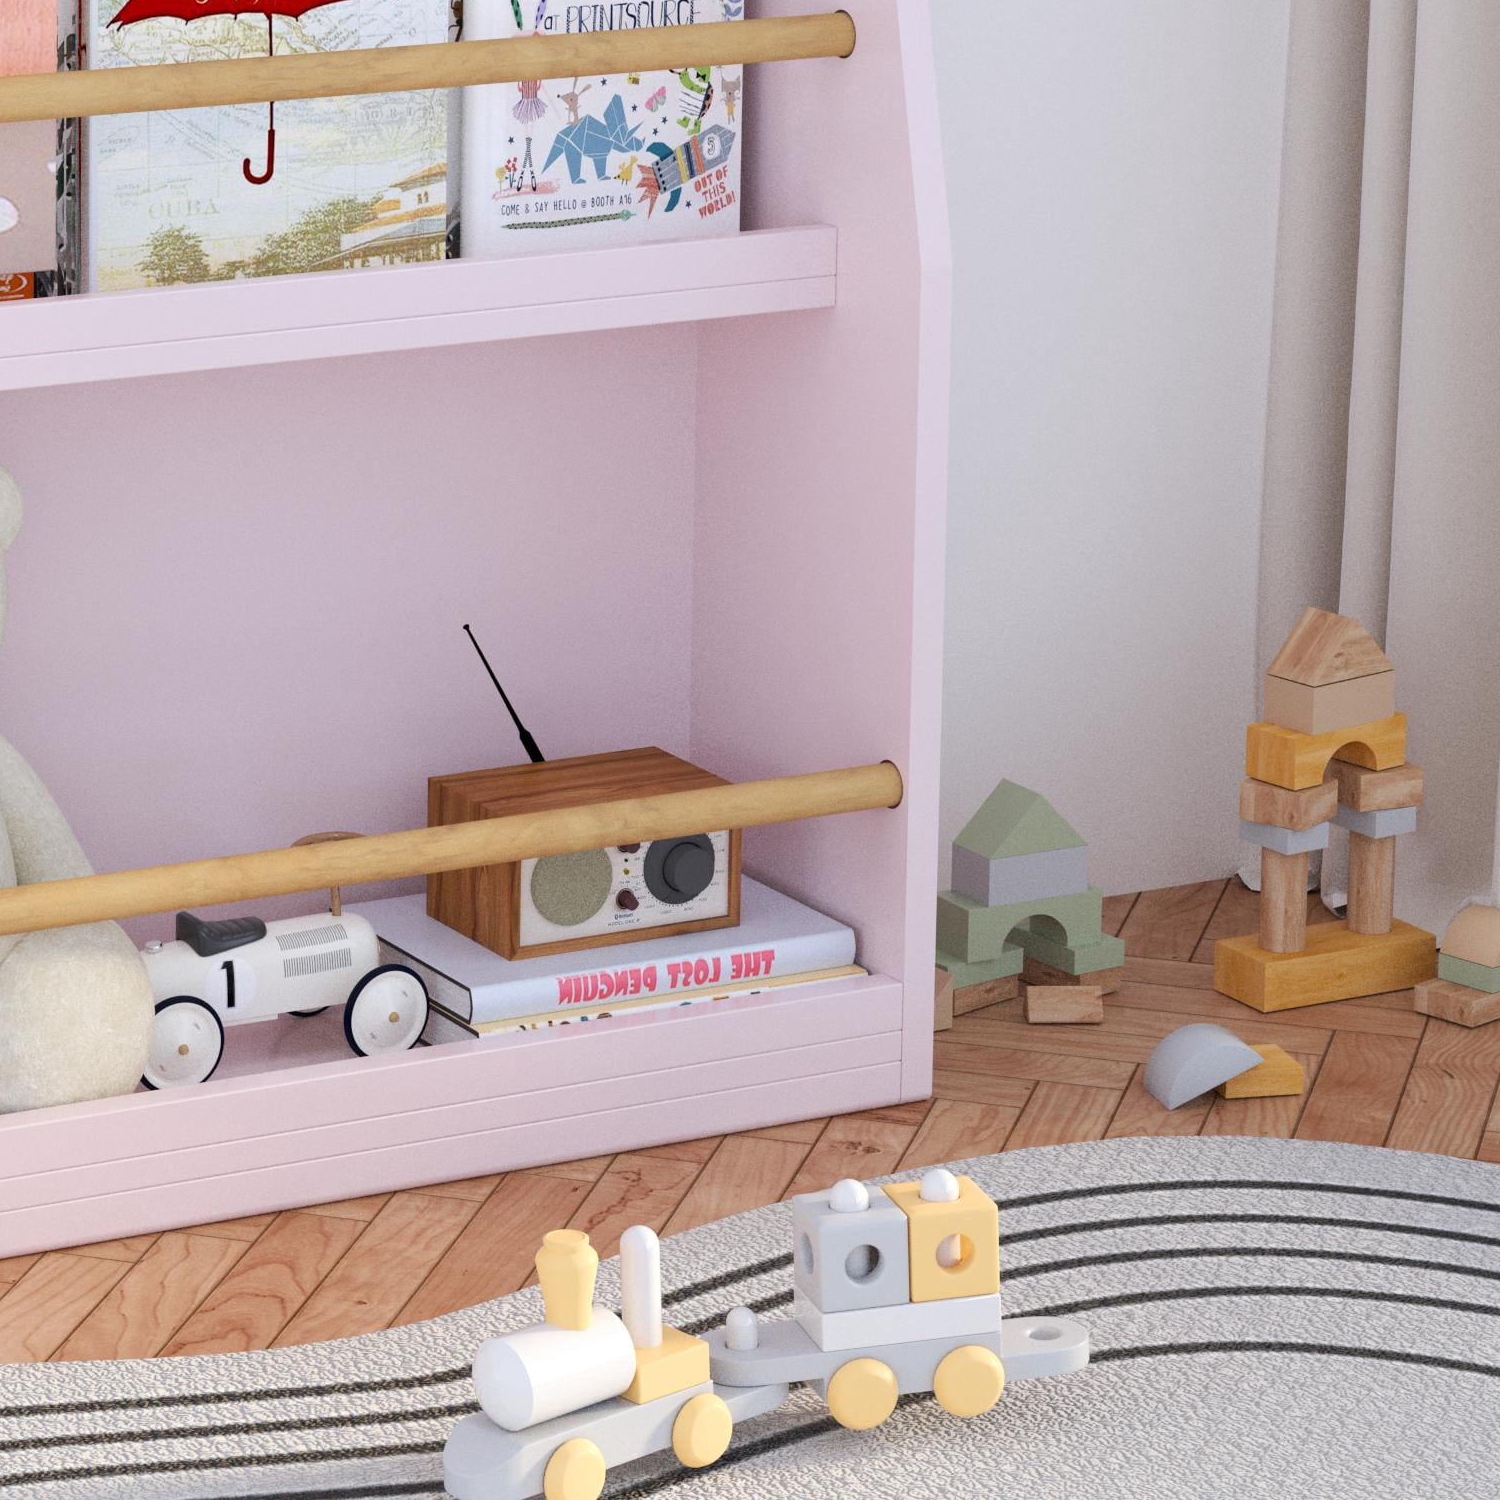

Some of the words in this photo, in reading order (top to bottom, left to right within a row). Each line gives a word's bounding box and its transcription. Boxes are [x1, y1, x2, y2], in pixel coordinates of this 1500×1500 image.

[694, 173, 713, 193] OUT
[715, 164, 728, 181] OF
[701, 181, 726, 202] THIS
[500, 204, 520, 216] COME
[524, 203, 530, 214] &
[534, 202, 549, 213] SAY
[553, 199, 577, 211] HELLO
[581, 199, 587, 209] @
[590, 195, 615, 208] BOOTH
[618, 193, 632, 205] A16
[698, 190, 736, 219] WORLD!
[220, 960, 236, 1009] 1
